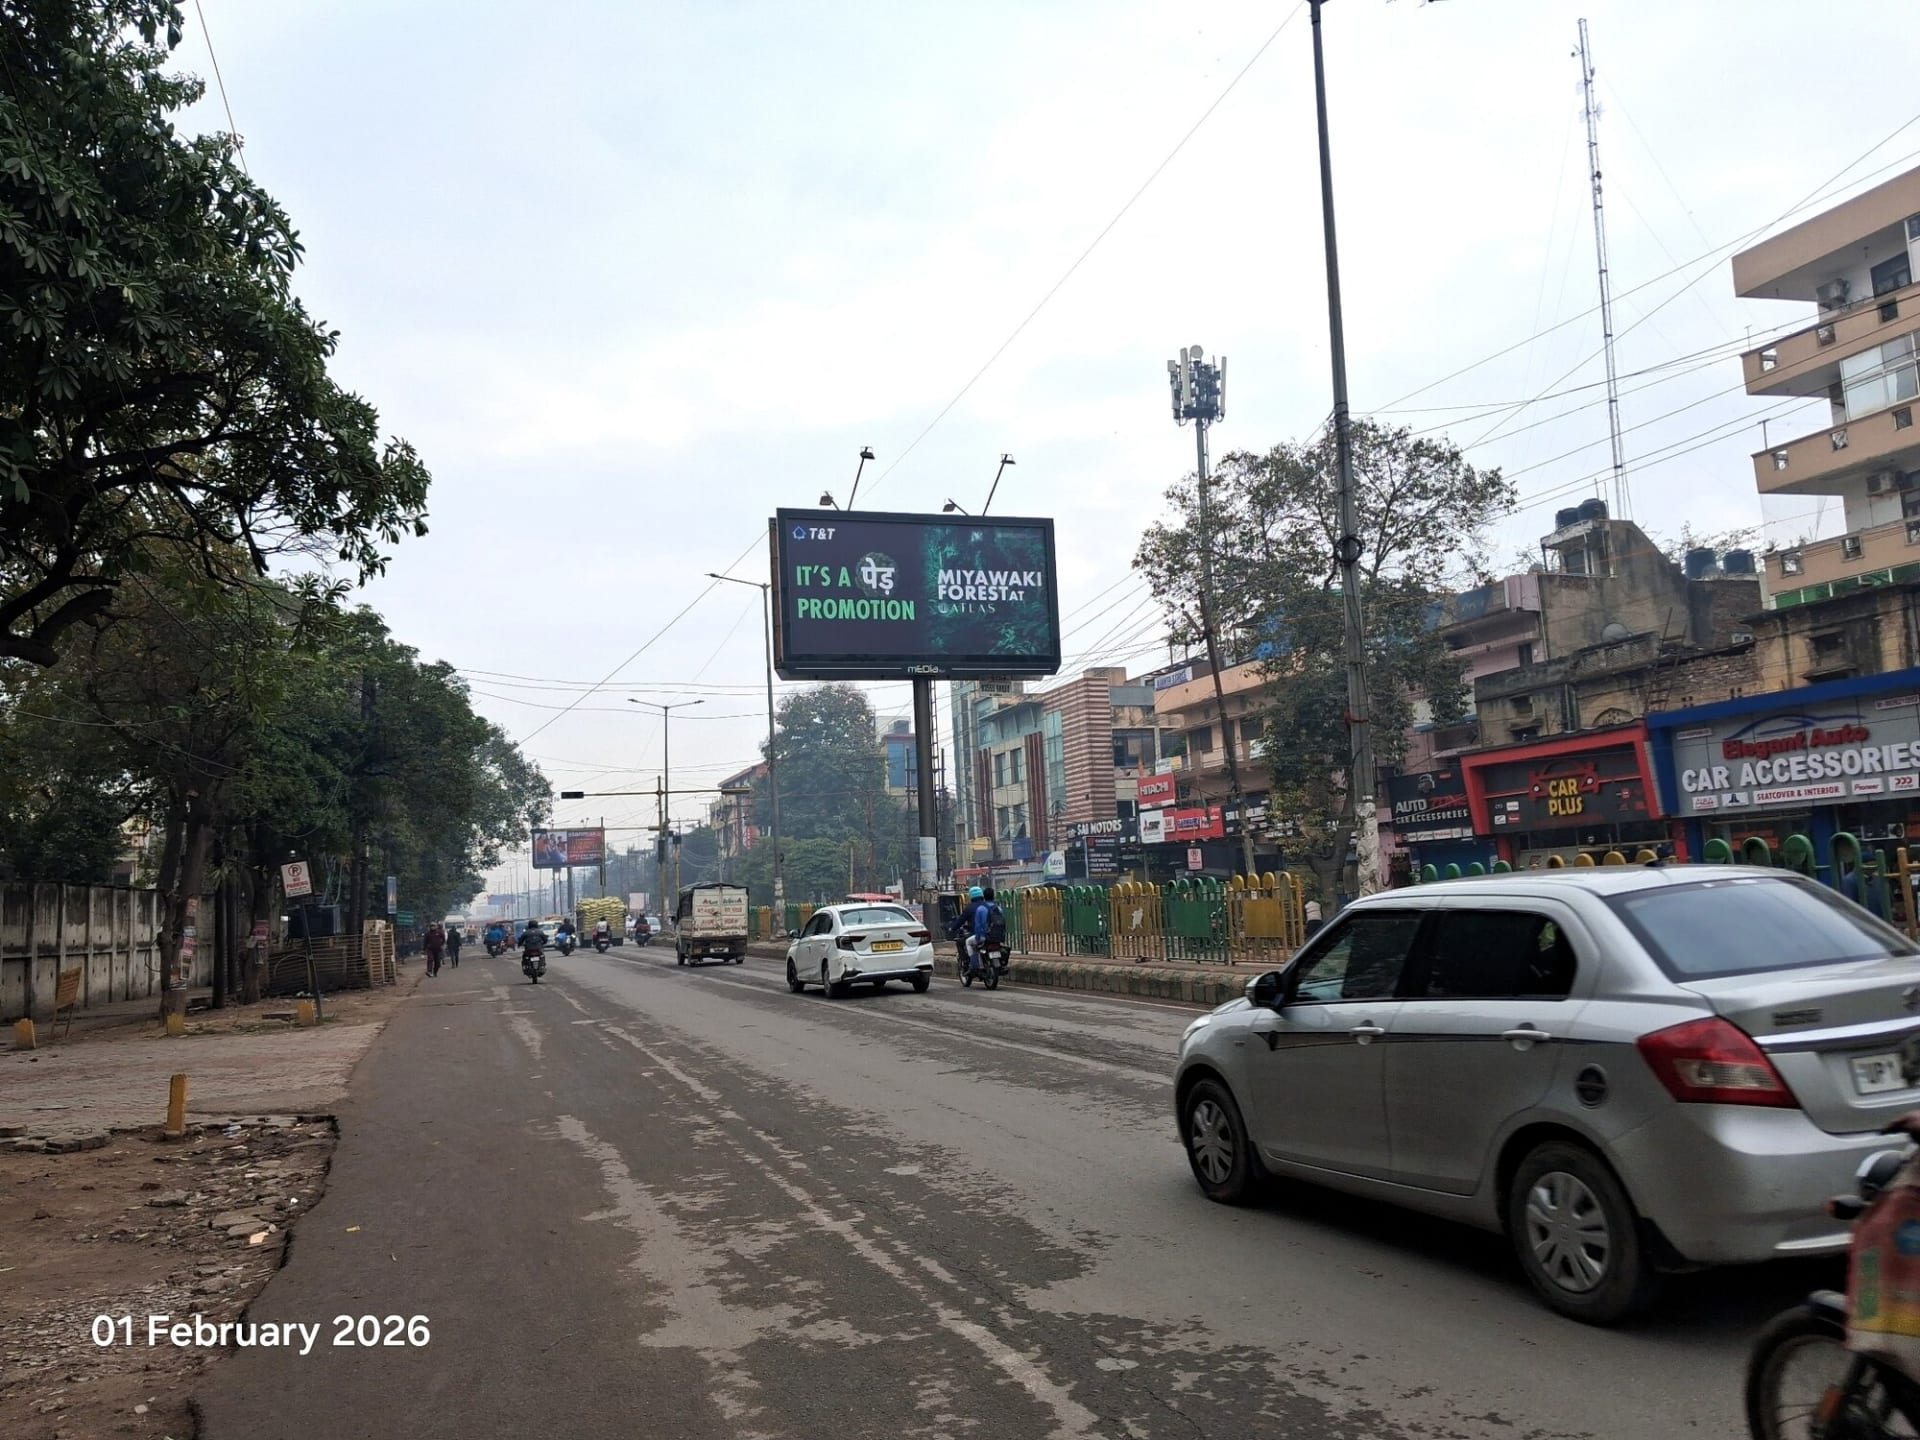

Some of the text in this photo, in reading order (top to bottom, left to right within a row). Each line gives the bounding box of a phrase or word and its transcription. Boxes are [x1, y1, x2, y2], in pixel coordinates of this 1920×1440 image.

[809, 528, 835, 540] T&T
[796, 557, 895, 595] IT'S A पेड़
[938, 569, 1042, 587] MIYAWAKI
[938, 585, 1024, 601] FOREST AT
[797, 598, 915, 620] PROMOTION
[951, 602, 996, 614] ATLAS
[1723, 732, 1807, 760] Elegant
[1809, 723, 1870, 748] Auto
[1682, 741, 1920, 792] CAR ACCESSORIES
[1140, 781, 1169, 796] HITACHI
[1549, 778, 1578, 797] CAR
[1757, 789, 1795, 800] SEATCOVER
[1805, 785, 1839, 796] INTERIOR
[1396, 798, 1427, 813] AUTO
[1548, 796, 1583, 816] PLUS
[1411, 808, 1469, 823] ACCESSORIES
[1077, 819, 1122, 835] SAI MOTORS
